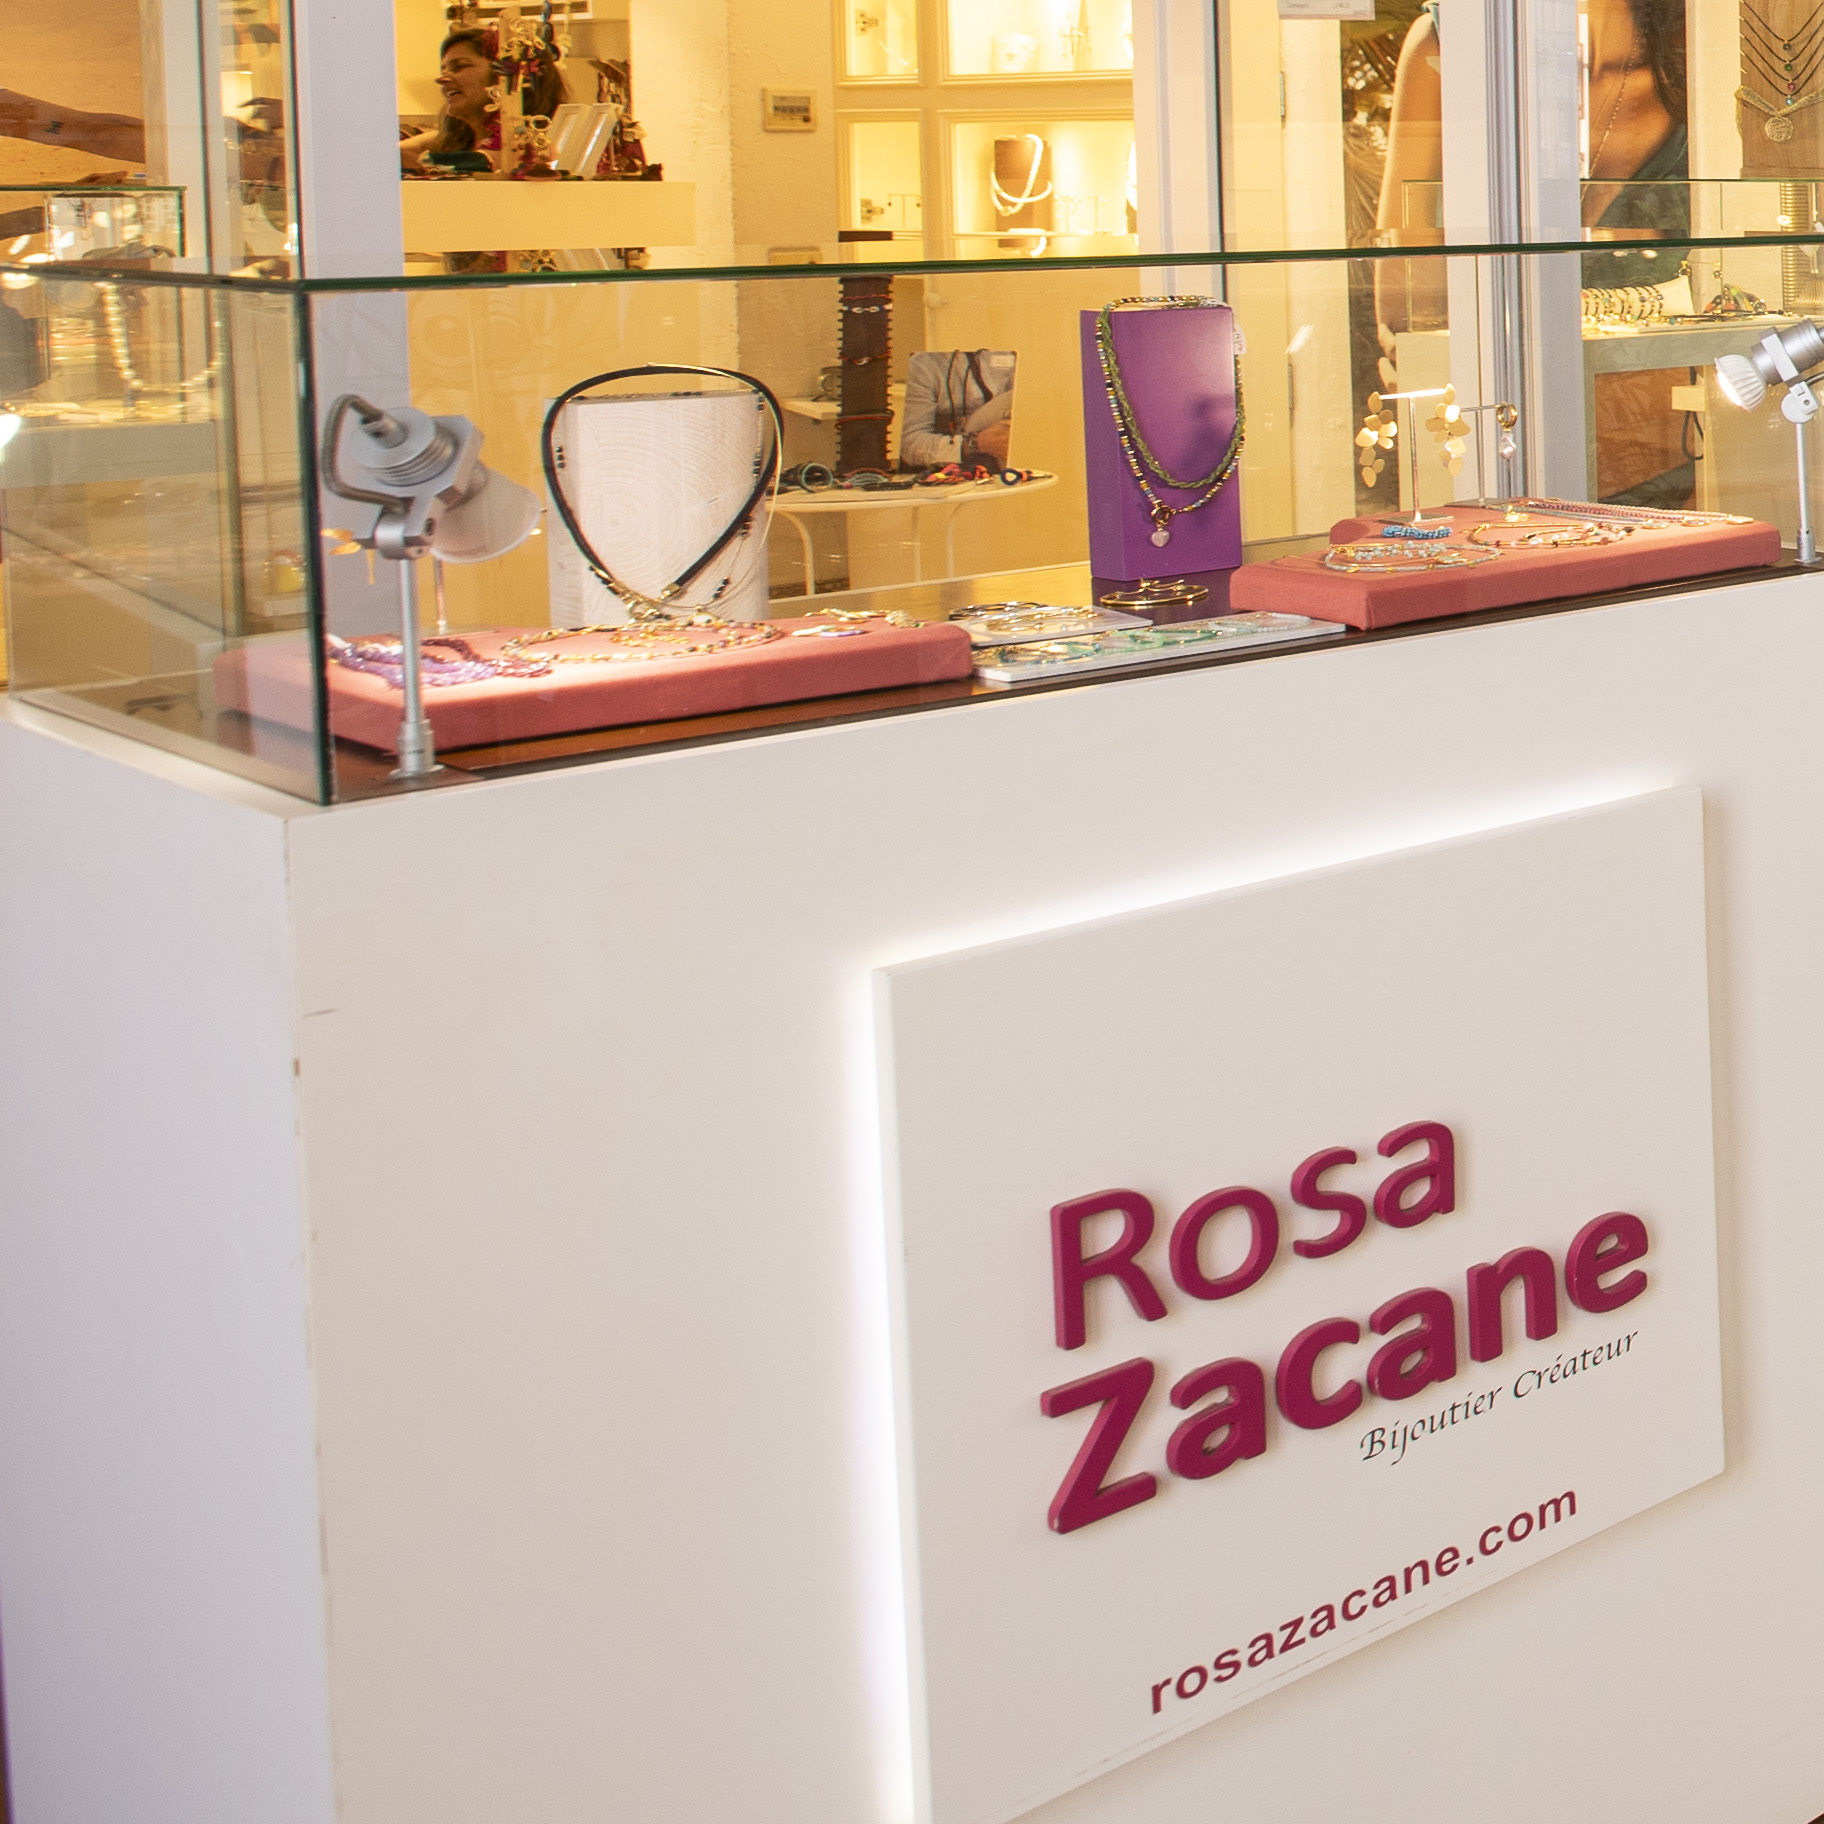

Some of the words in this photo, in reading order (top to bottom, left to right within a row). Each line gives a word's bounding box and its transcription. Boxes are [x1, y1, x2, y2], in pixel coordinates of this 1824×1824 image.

[1050, 1120, 1456, 1351] Rosa
[1040, 1211, 1650, 1535] Zacane
[1359, 1384, 1504, 1466] Bijoutier
[1512, 1327, 1640, 1402] Créateur
[1150, 1487, 1579, 1715] rosazacane.com
